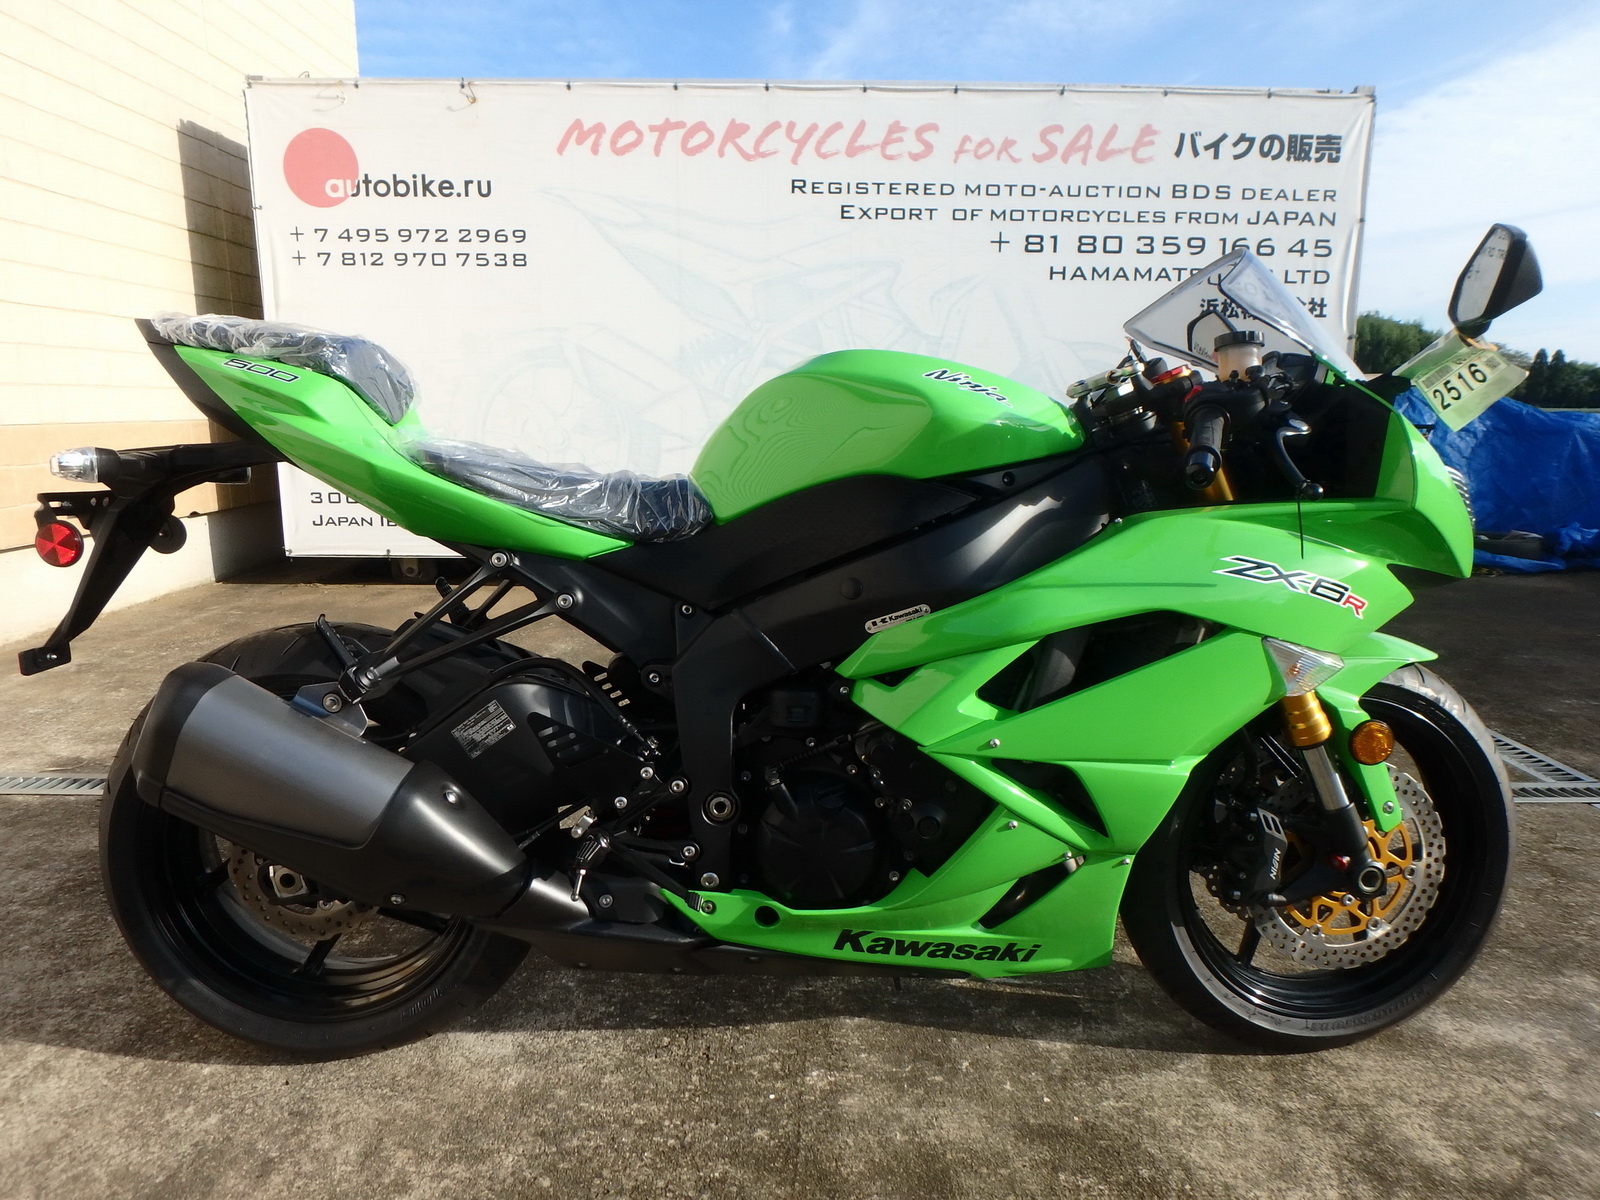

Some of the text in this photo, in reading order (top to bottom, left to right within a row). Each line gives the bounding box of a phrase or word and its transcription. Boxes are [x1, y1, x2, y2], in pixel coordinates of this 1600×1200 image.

[556, 117, 940, 165] MOTORCYCLES
[1031, 123, 1161, 165] SALE
[1174, 132, 1342, 164] バイクの販売
[325, 173, 492, 198] autobike.ru
[965, 184, 1161, 199] MOTO-AUCTION
[1171, 184, 1231, 200] BDS
[1241, 188, 1337, 202] DEALER
[840, 205, 1337, 226] EXPORT OF MOTORCYCLES FROM JAPAN
[314, 228, 328, 243] 7
[338, 228, 389, 243] 495
[398, 228, 448, 243] 972
[458, 228, 527, 243] 2969
[1024, 235, 1059, 253] 81
[1077, 235, 1123, 254] 80
[1136, 236, 1206, 255] 359
[1287, 239, 1333, 258] 45
[317, 252, 331, 266] 7
[341, 252, 384, 266] 812
[394, 252, 446, 267] 970
[456, 253, 527, 267] 7538
[1284, 269, 1330, 285] LTD
[223, 359, 299, 383] 600
[922, 368, 1014, 408] Ninja
[1432, 363, 1488, 410] 2516
[312, 514, 373, 526] JAPAN
[1212, 555, 1368, 620] ZX-6R
[888, 606, 923, 622] Kawasaki
[833, 929, 1042, 963] Kawasaki
